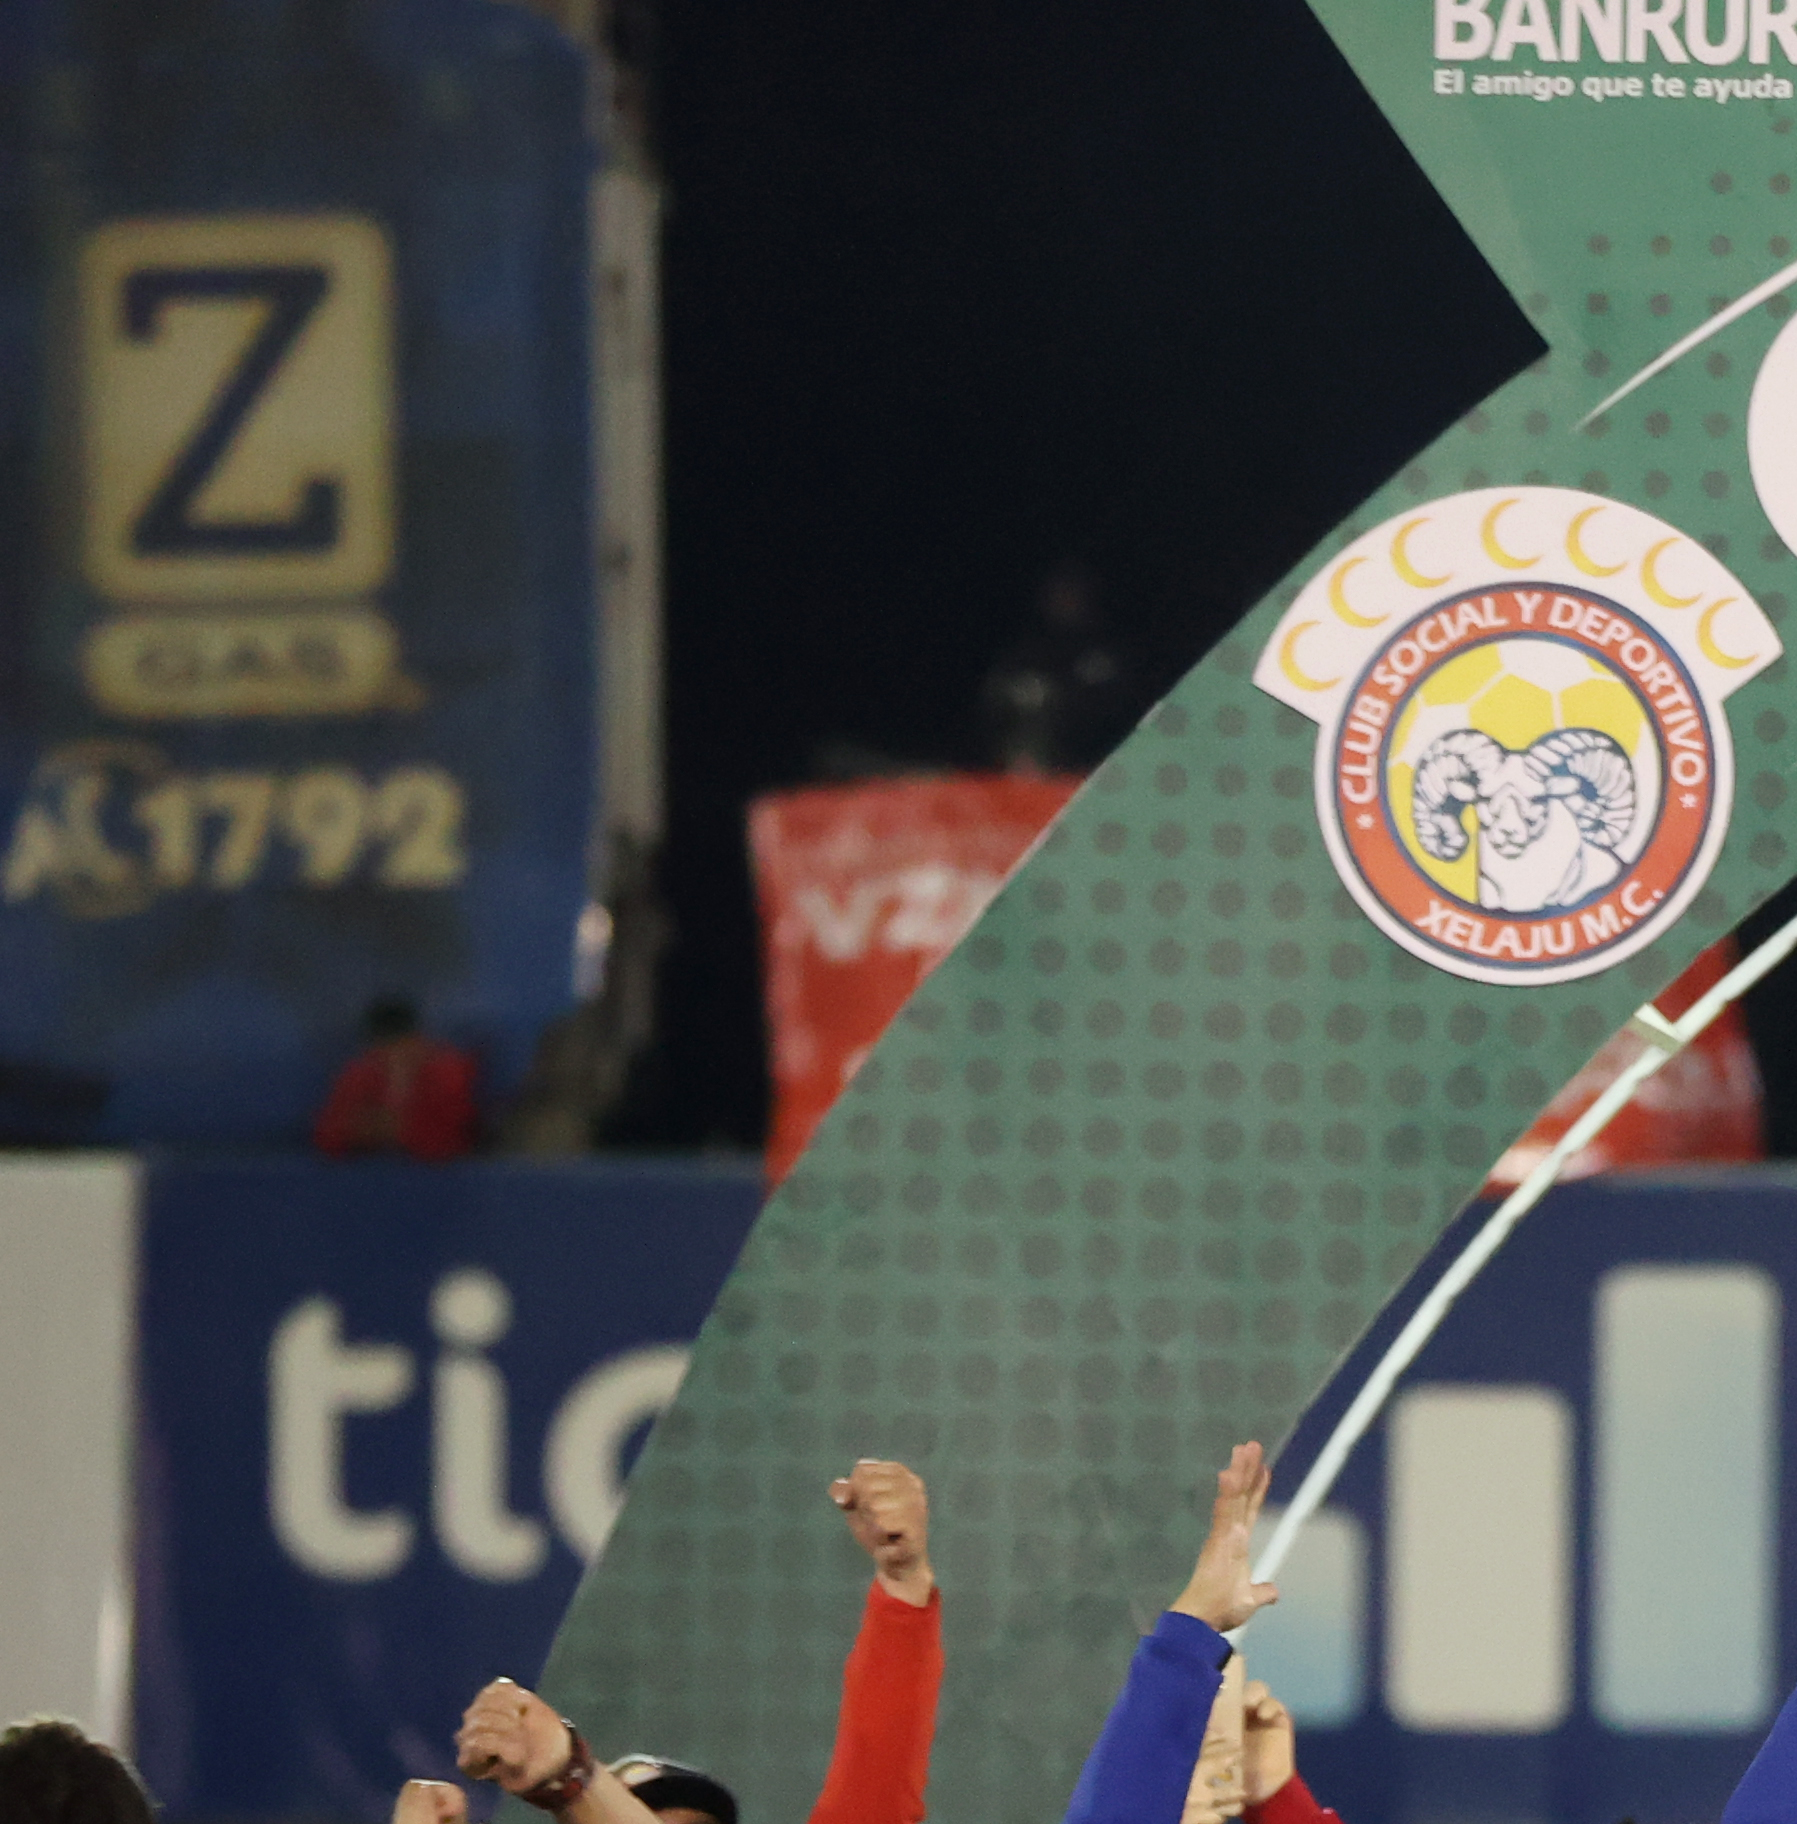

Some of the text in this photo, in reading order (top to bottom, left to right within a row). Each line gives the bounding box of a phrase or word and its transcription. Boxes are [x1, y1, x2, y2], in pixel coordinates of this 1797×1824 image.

[1433, 68, 1464, 94] El
[1472, 69, 1575, 103] amigo
[1581, 73, 1644, 103] que
[1652, 70, 1688, 98] te
[1692, 72, 1793, 105] ayuda
[120, 264, 343, 558] Z
[1341, 592, 1707, 805] CLUB SOCIAL Y DEPORTIVO
[1414, 880, 1666, 958] XELAJU M.C.
